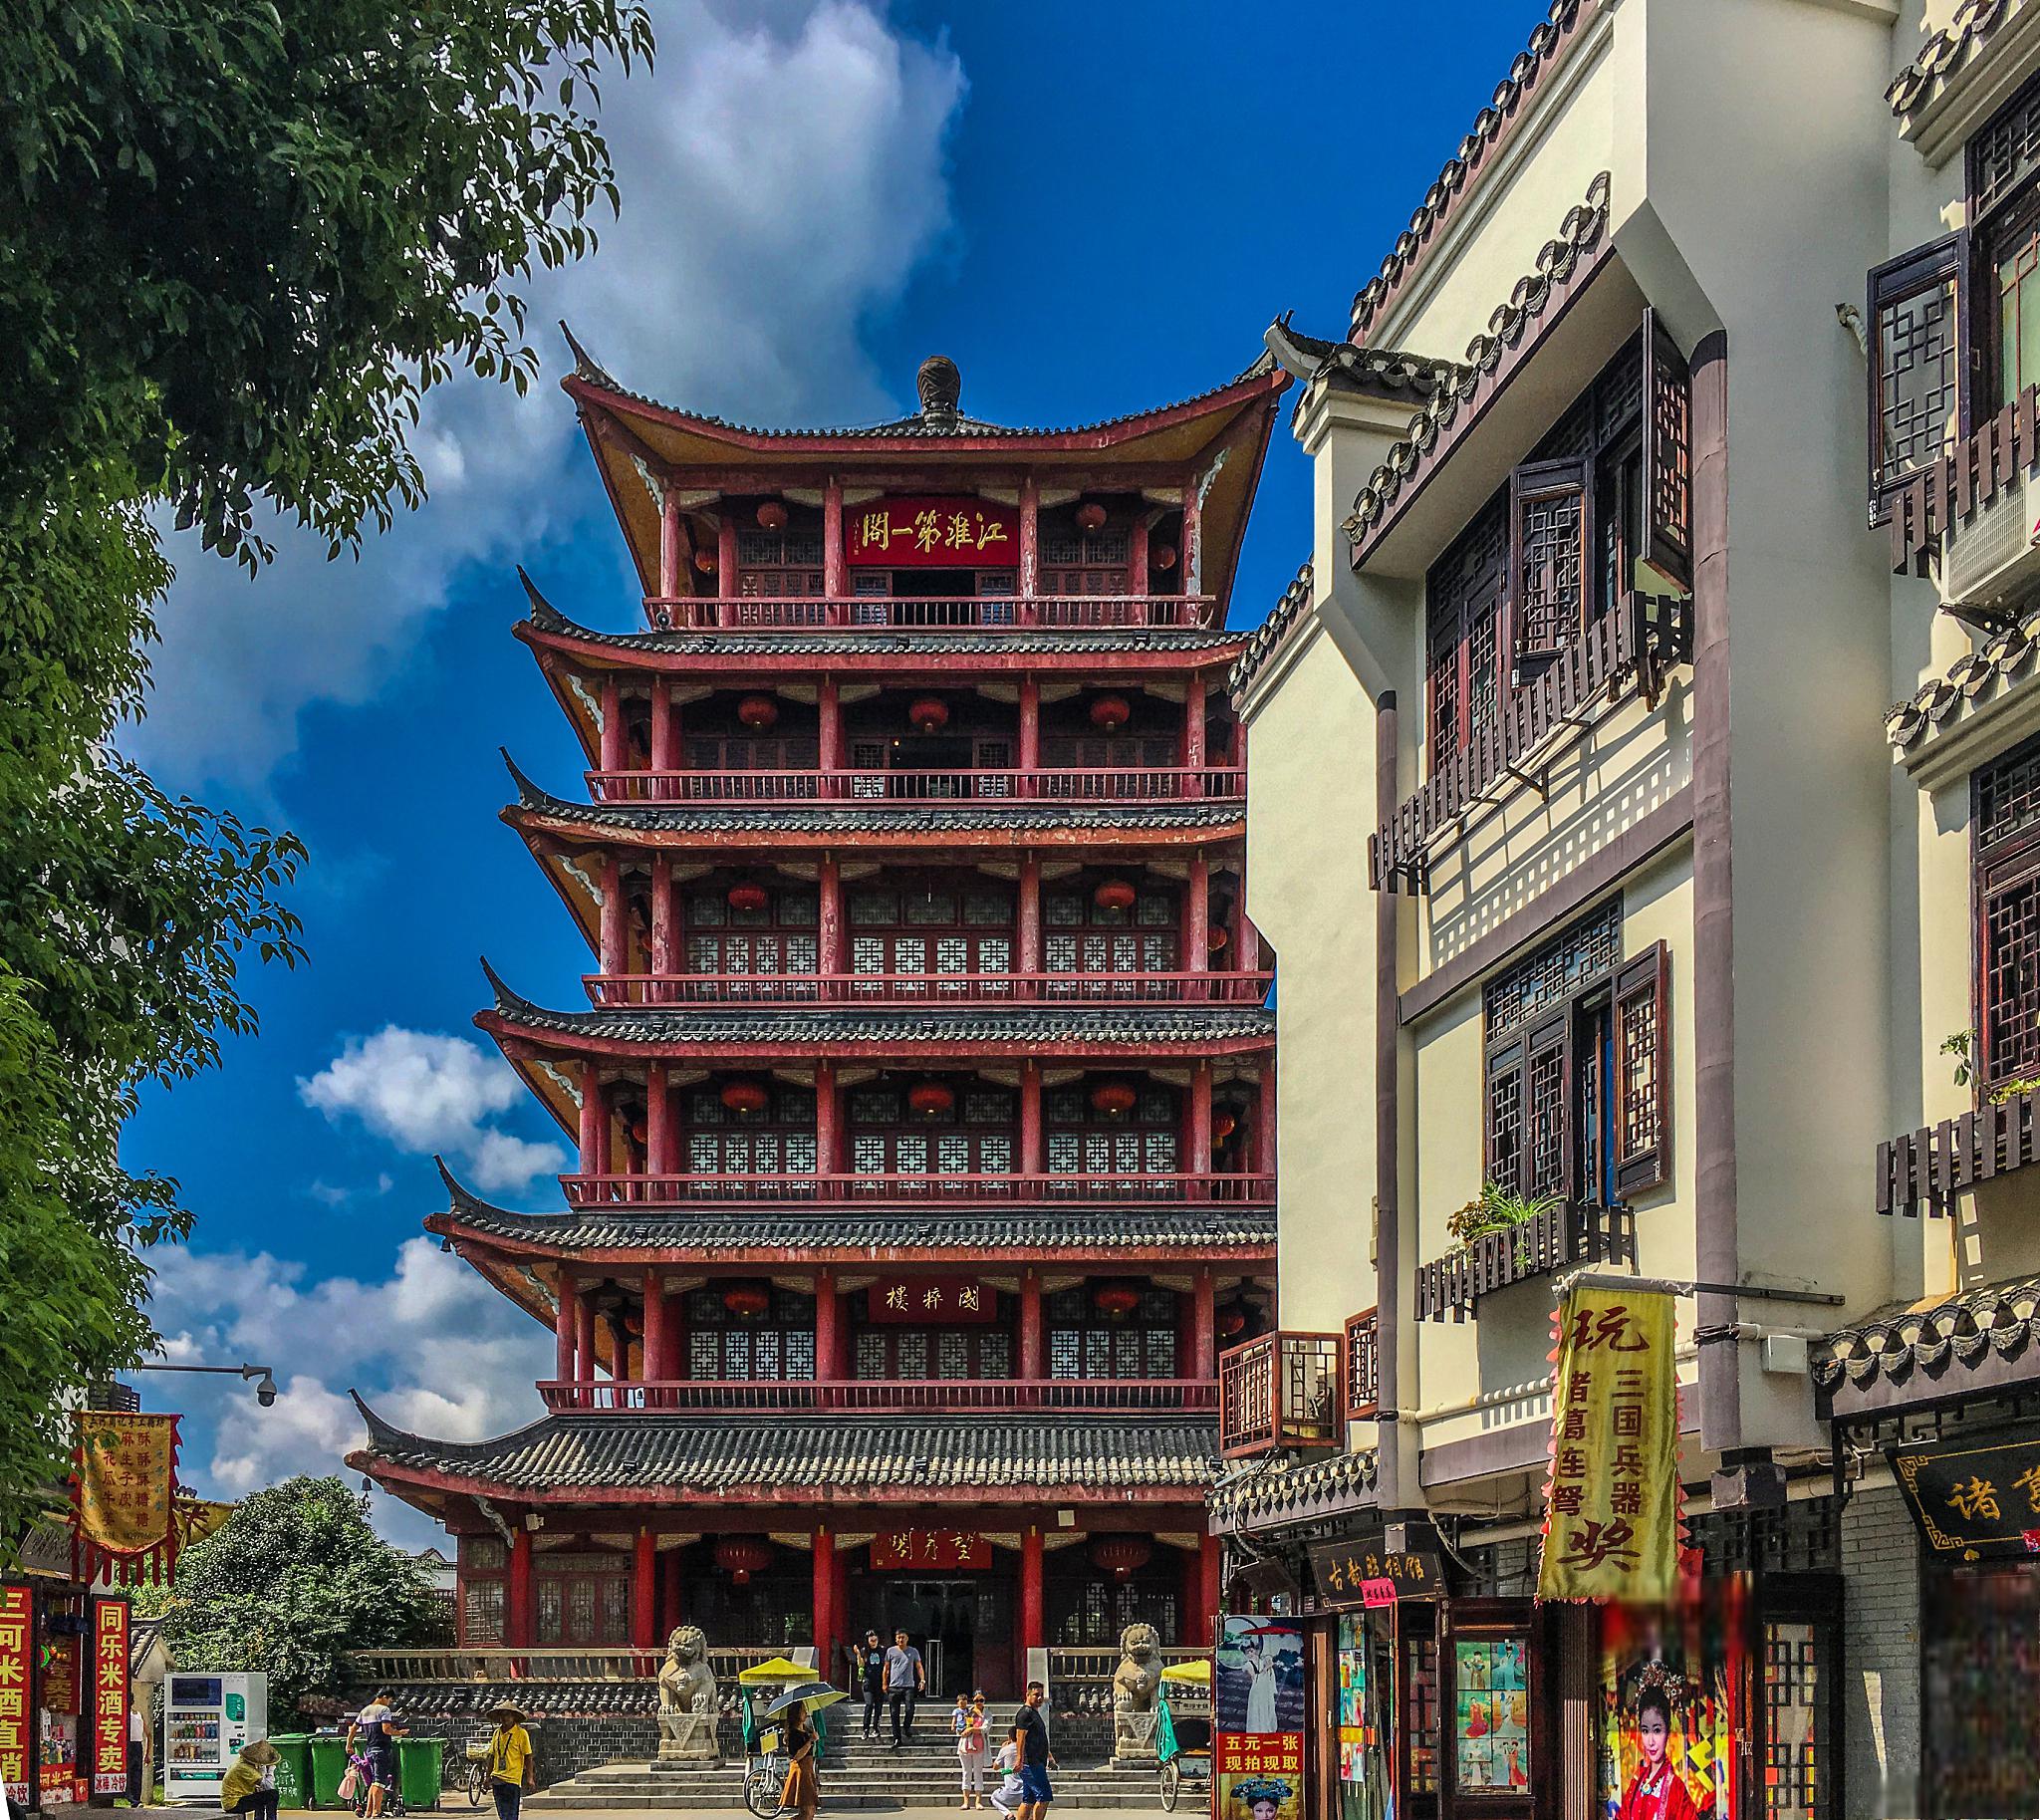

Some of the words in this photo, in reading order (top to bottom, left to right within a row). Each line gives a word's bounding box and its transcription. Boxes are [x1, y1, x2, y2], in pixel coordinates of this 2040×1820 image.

[1572, 1305, 1650, 1352] 玩
[1611, 1369, 1645, 1515] 三国兵器
[99, 1606, 125, 1771] 同乐米酒专卖
[1225, 1735, 1299, 1751] 五元一张
[1225, 1755, 1299, 1771] 现拍现取
